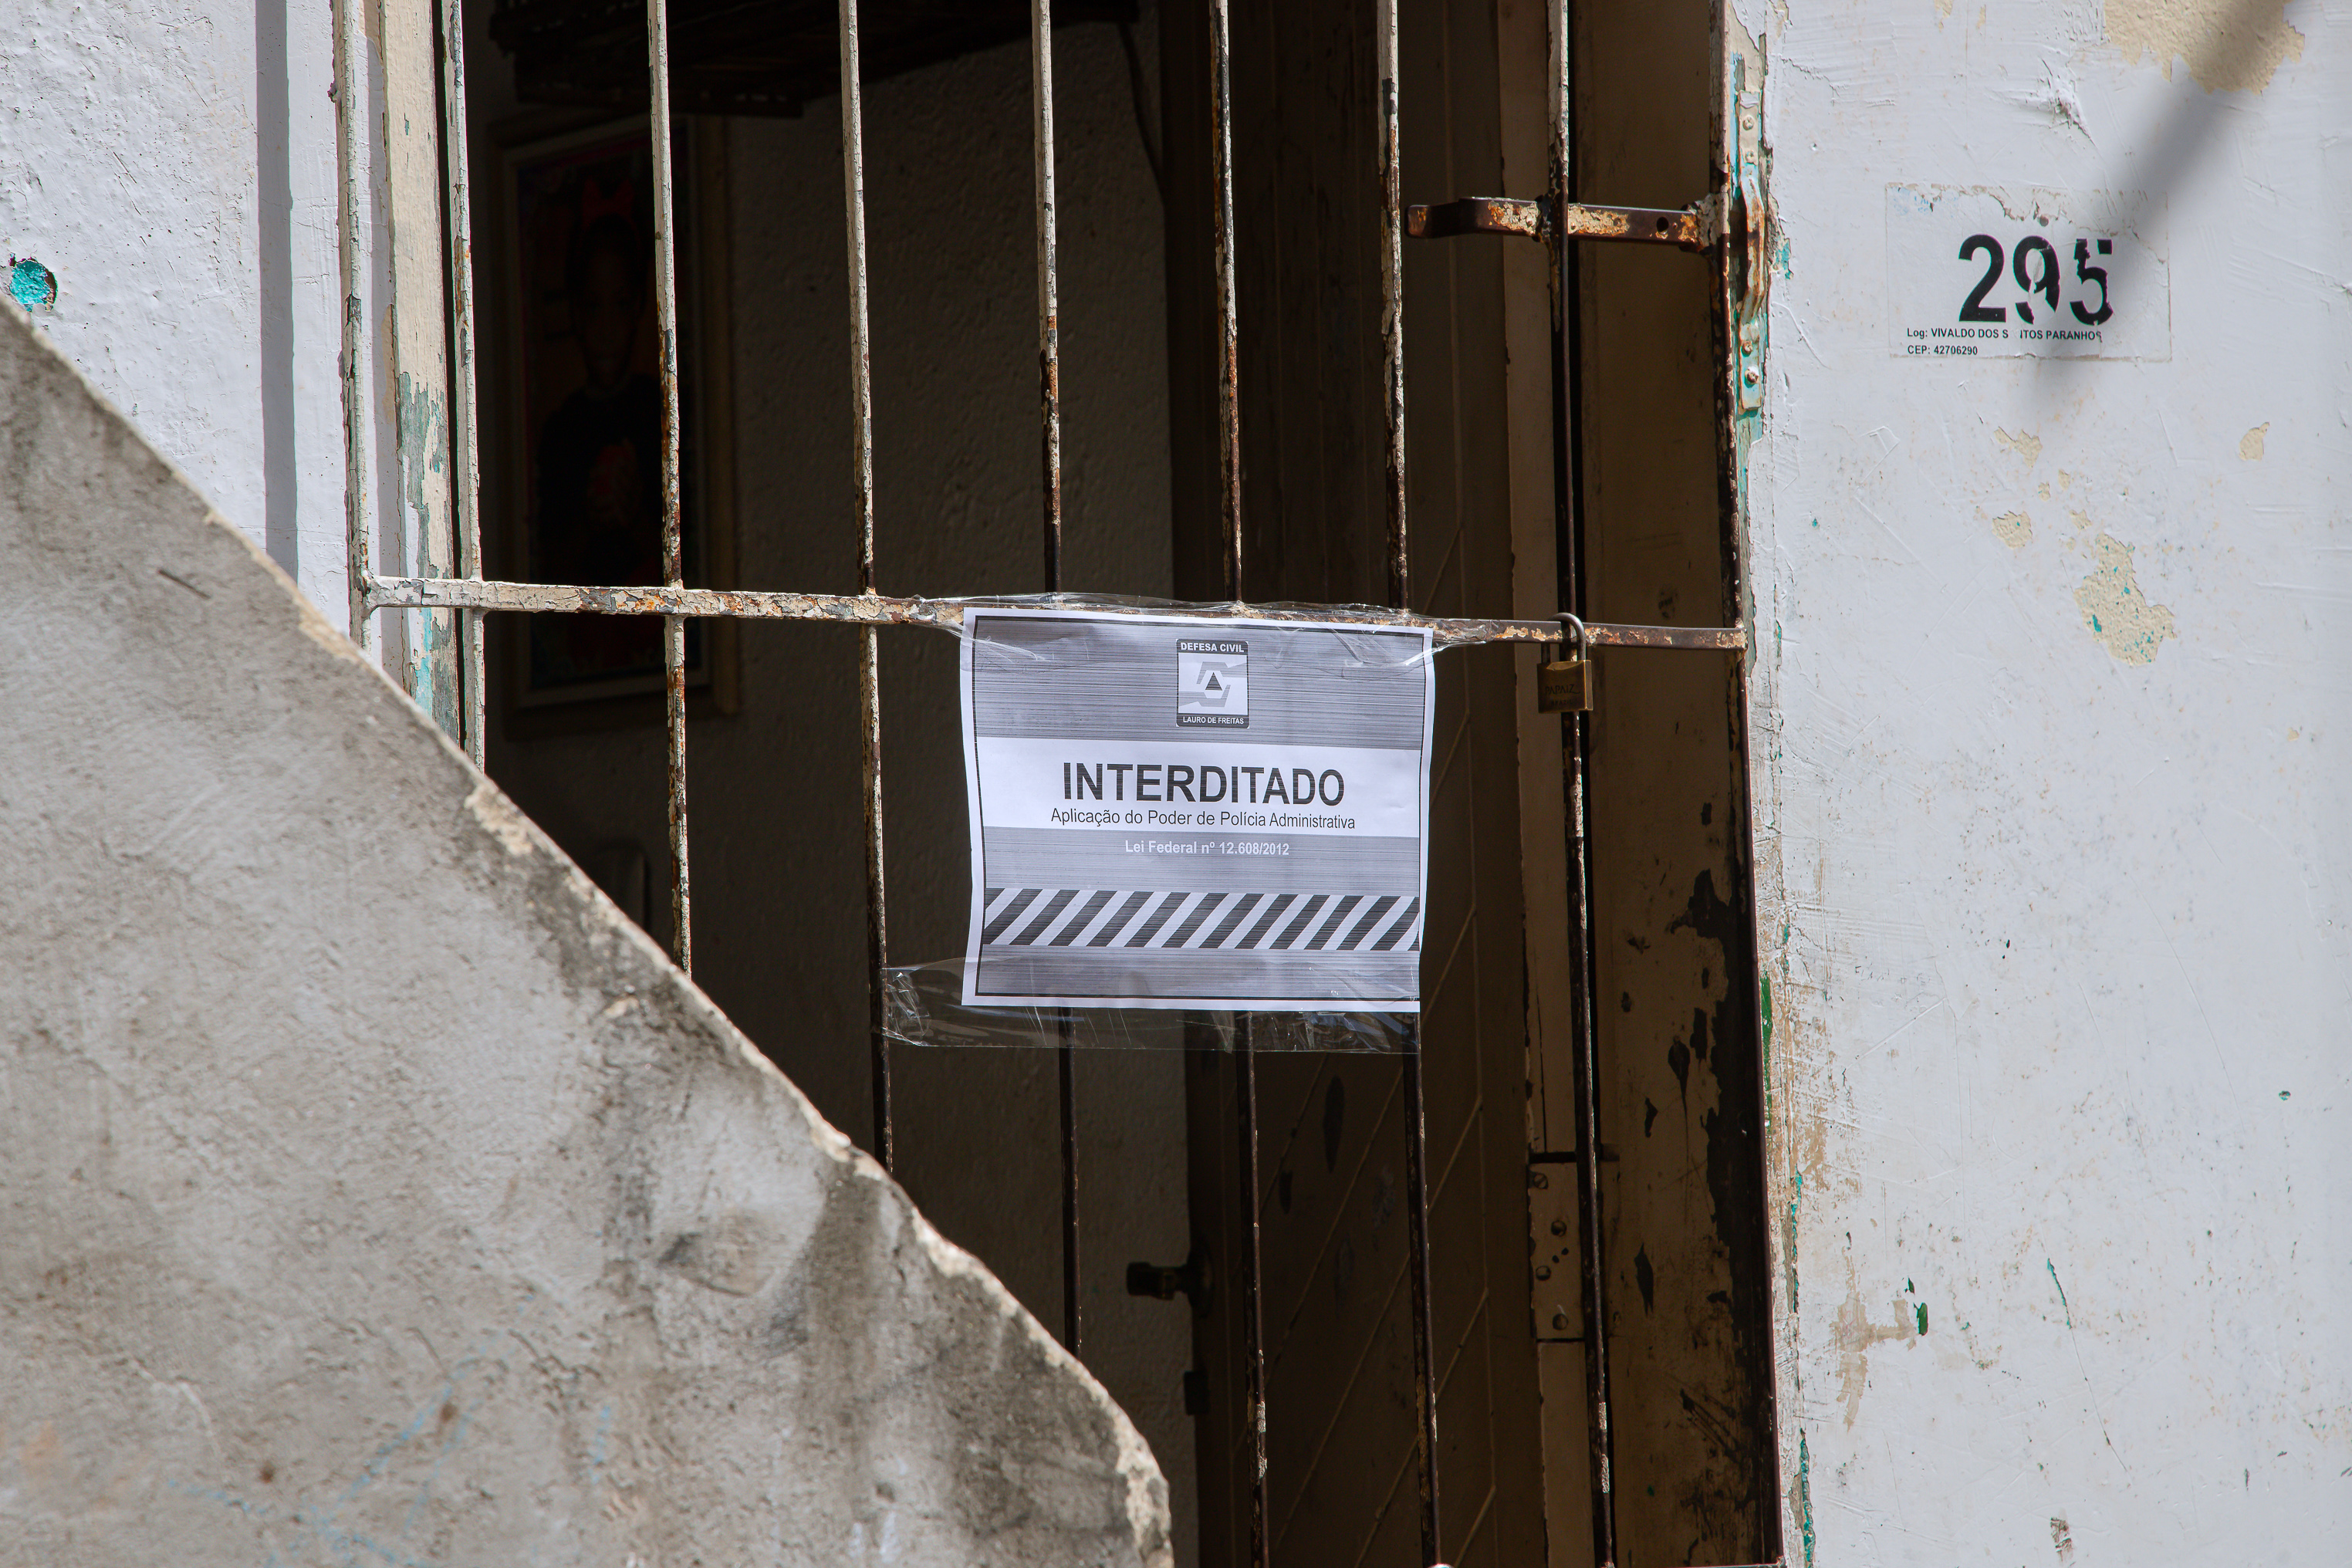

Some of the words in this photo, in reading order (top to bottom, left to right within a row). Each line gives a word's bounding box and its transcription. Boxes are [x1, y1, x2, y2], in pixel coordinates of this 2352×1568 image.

[1958, 233, 2114, 326] 295
[1907, 328, 1928, 339] Log:
[1931, 328, 1975, 338] VIVALDO
[1978, 329, 2000, 339] DOS
[2046, 329, 2103, 343] PARANHOS
[1908, 345, 1931, 354] CEP:
[1934, 346, 1978, 356] 42706290
[1181, 642, 1217, 651] DEFESA
[1219, 644, 1244, 652] CIVIL
[1545, 684, 1580, 694] PAPAIZ
[1063, 762, 1344, 806] INTERDITADO
[1051, 808, 1120, 826] Aplicação
[1125, 809, 1143, 824] do
[1148, 810, 1192, 825] Poder
[1197, 811, 1215, 826] de
[1221, 811, 1266, 826] Polícia
[1269, 813, 1355, 830] Administrativa
[1125, 840, 1144, 853] Lei
[1148, 840, 1197, 853] Federal
[1201, 842, 1215, 853] nº
[1219, 842, 1289, 856] 12.608/2012
